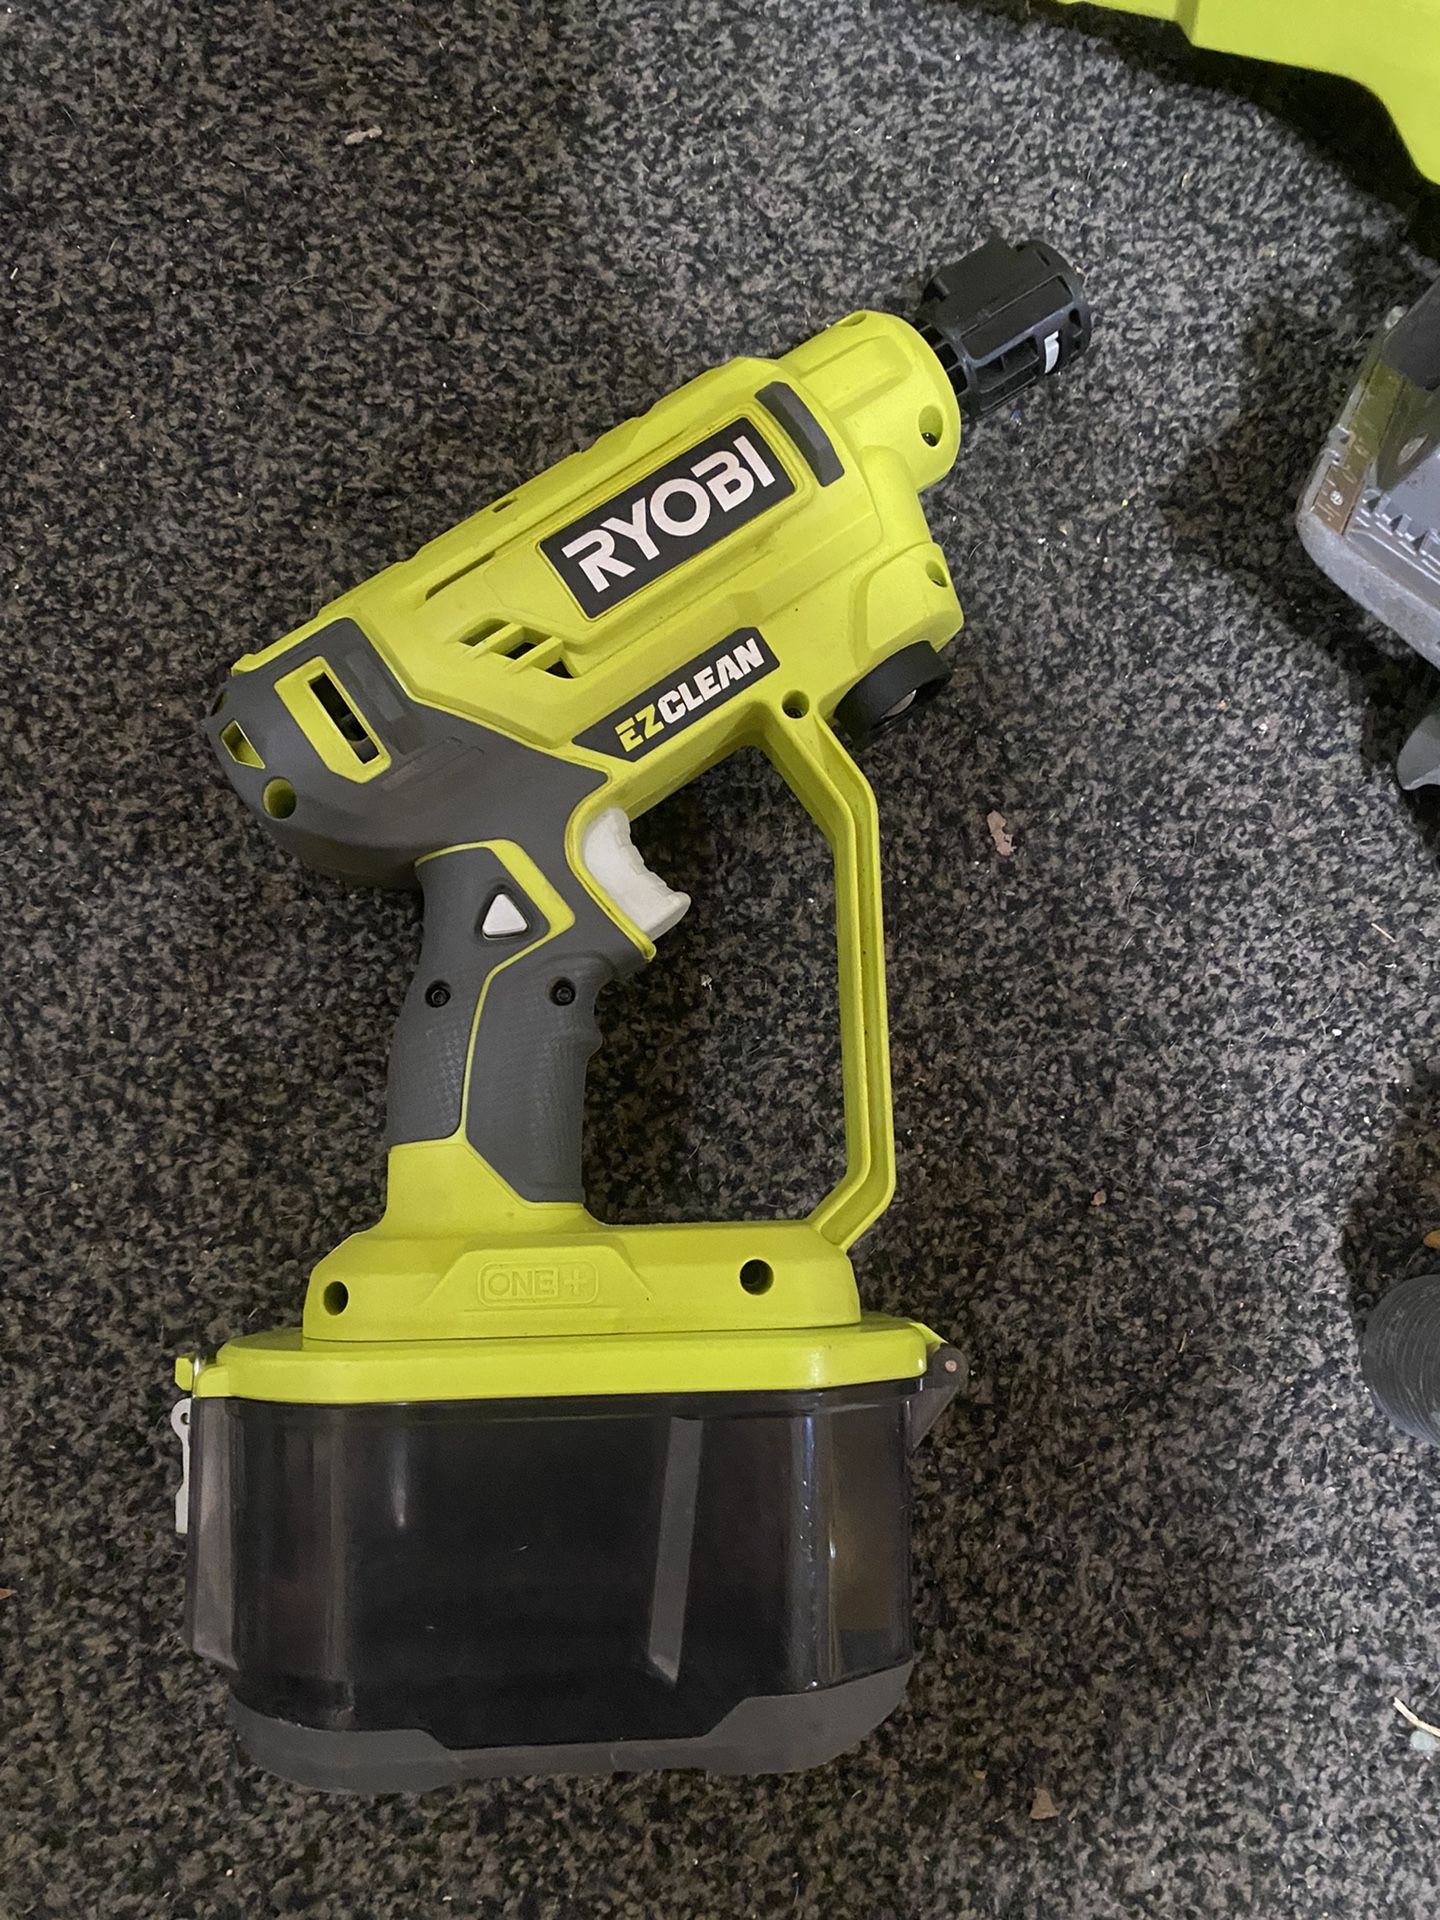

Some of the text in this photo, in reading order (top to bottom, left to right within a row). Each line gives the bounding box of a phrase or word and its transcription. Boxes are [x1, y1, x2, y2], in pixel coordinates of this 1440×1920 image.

[561, 435, 776, 592] RYOBI
[614, 637, 765, 752] EZCLEAN
[486, 1268, 588, 1298] ONE+
